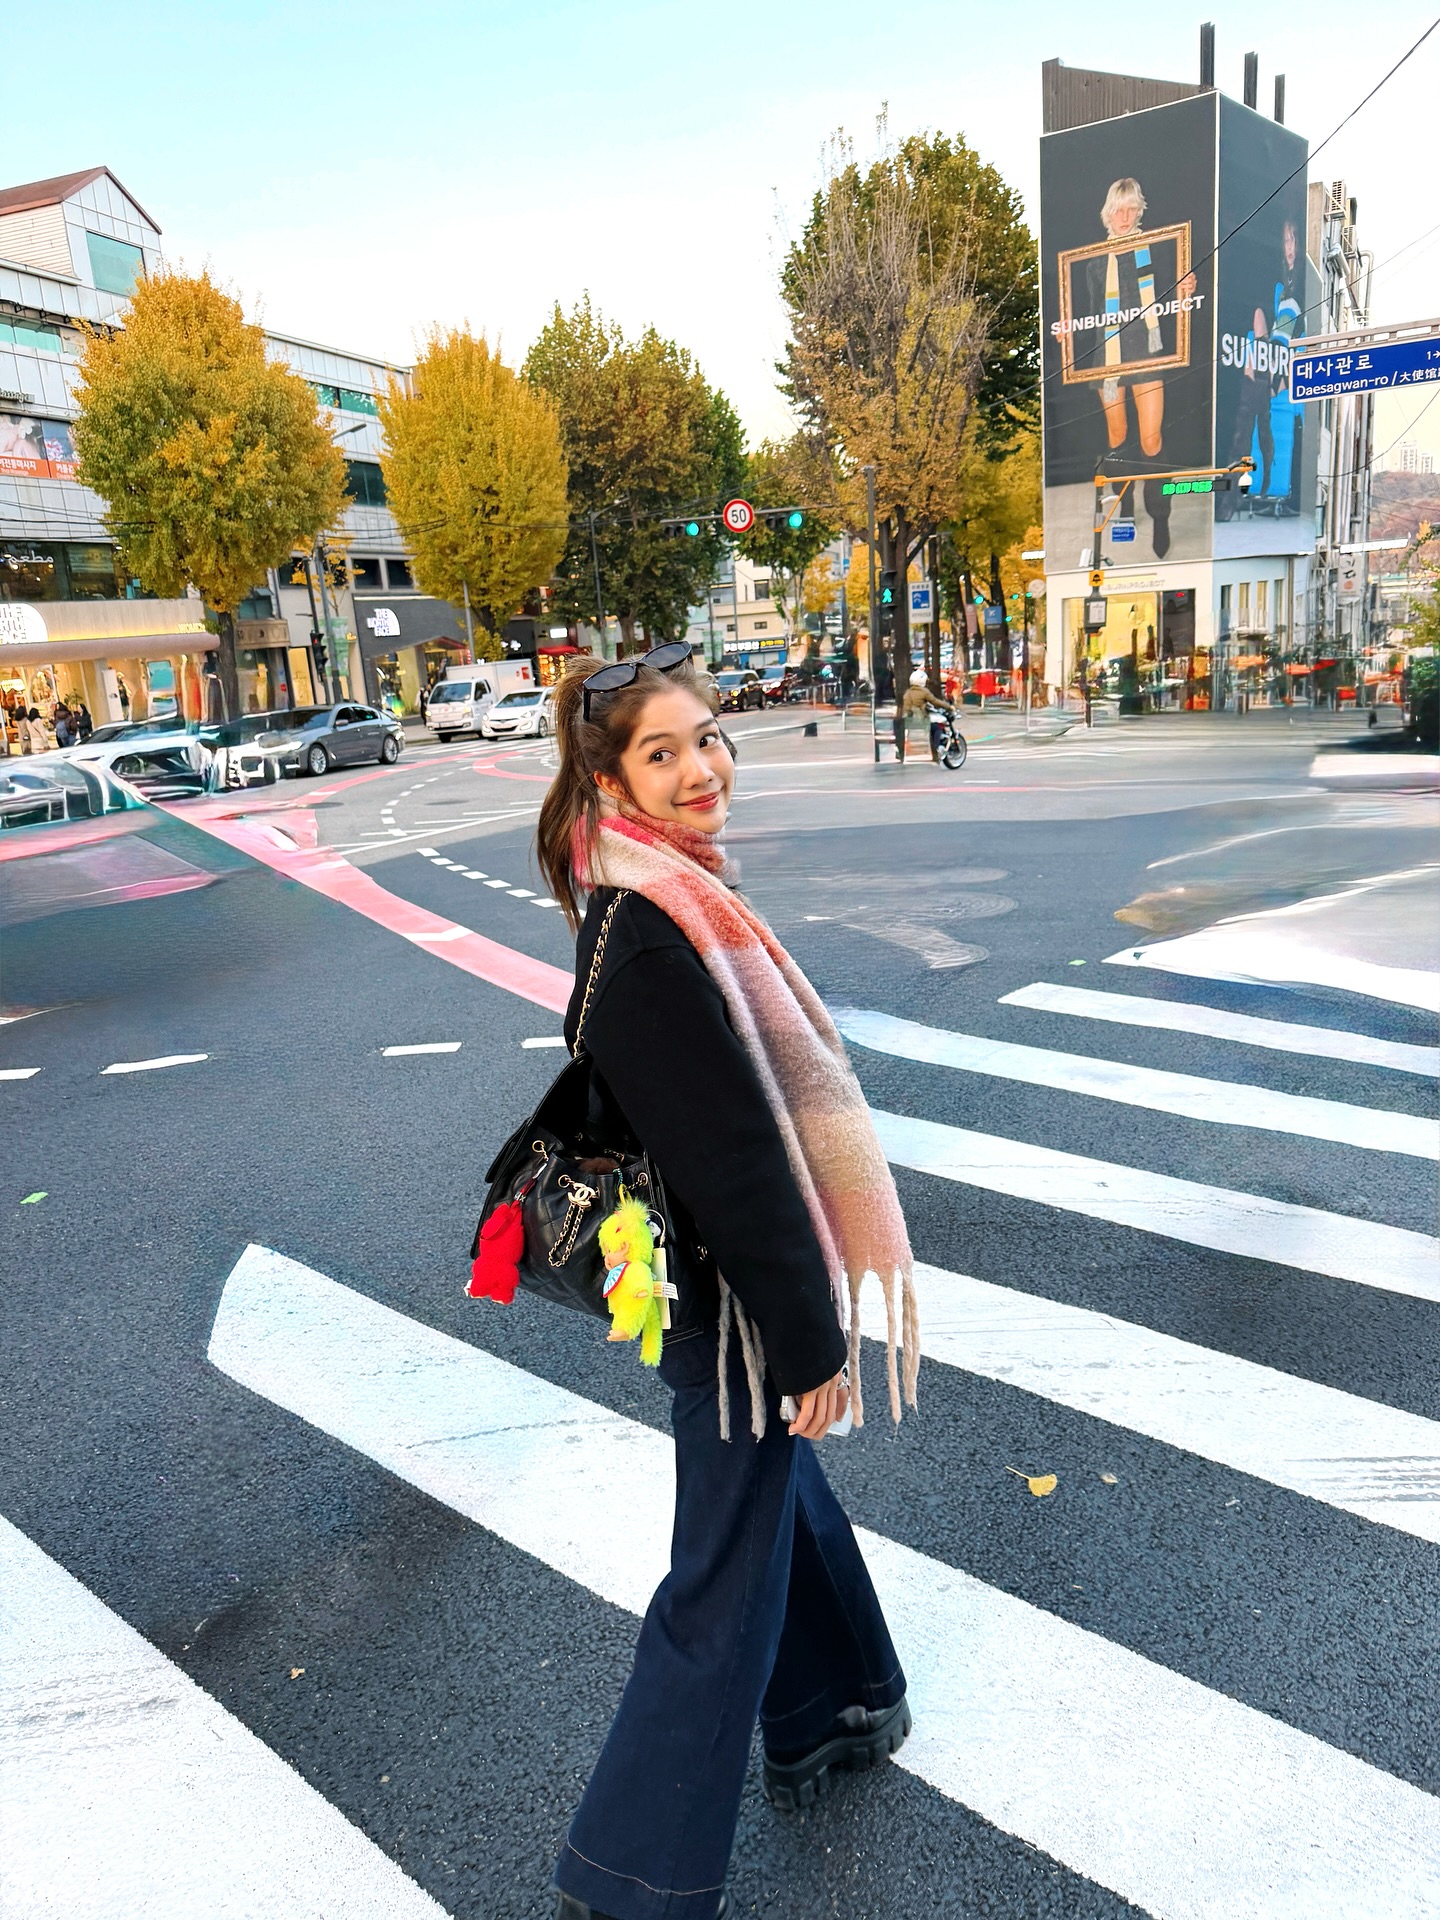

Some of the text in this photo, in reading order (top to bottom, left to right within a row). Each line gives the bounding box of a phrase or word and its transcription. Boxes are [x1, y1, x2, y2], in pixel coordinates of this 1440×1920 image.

[1050, 295, 1205, 335] SUNBURNPROJECT
[1296, 354, 1373, 379] 대사관로
[1296, 375, 1389, 397] Daesagwan-ro
[731, 508, 747, 524] 50
